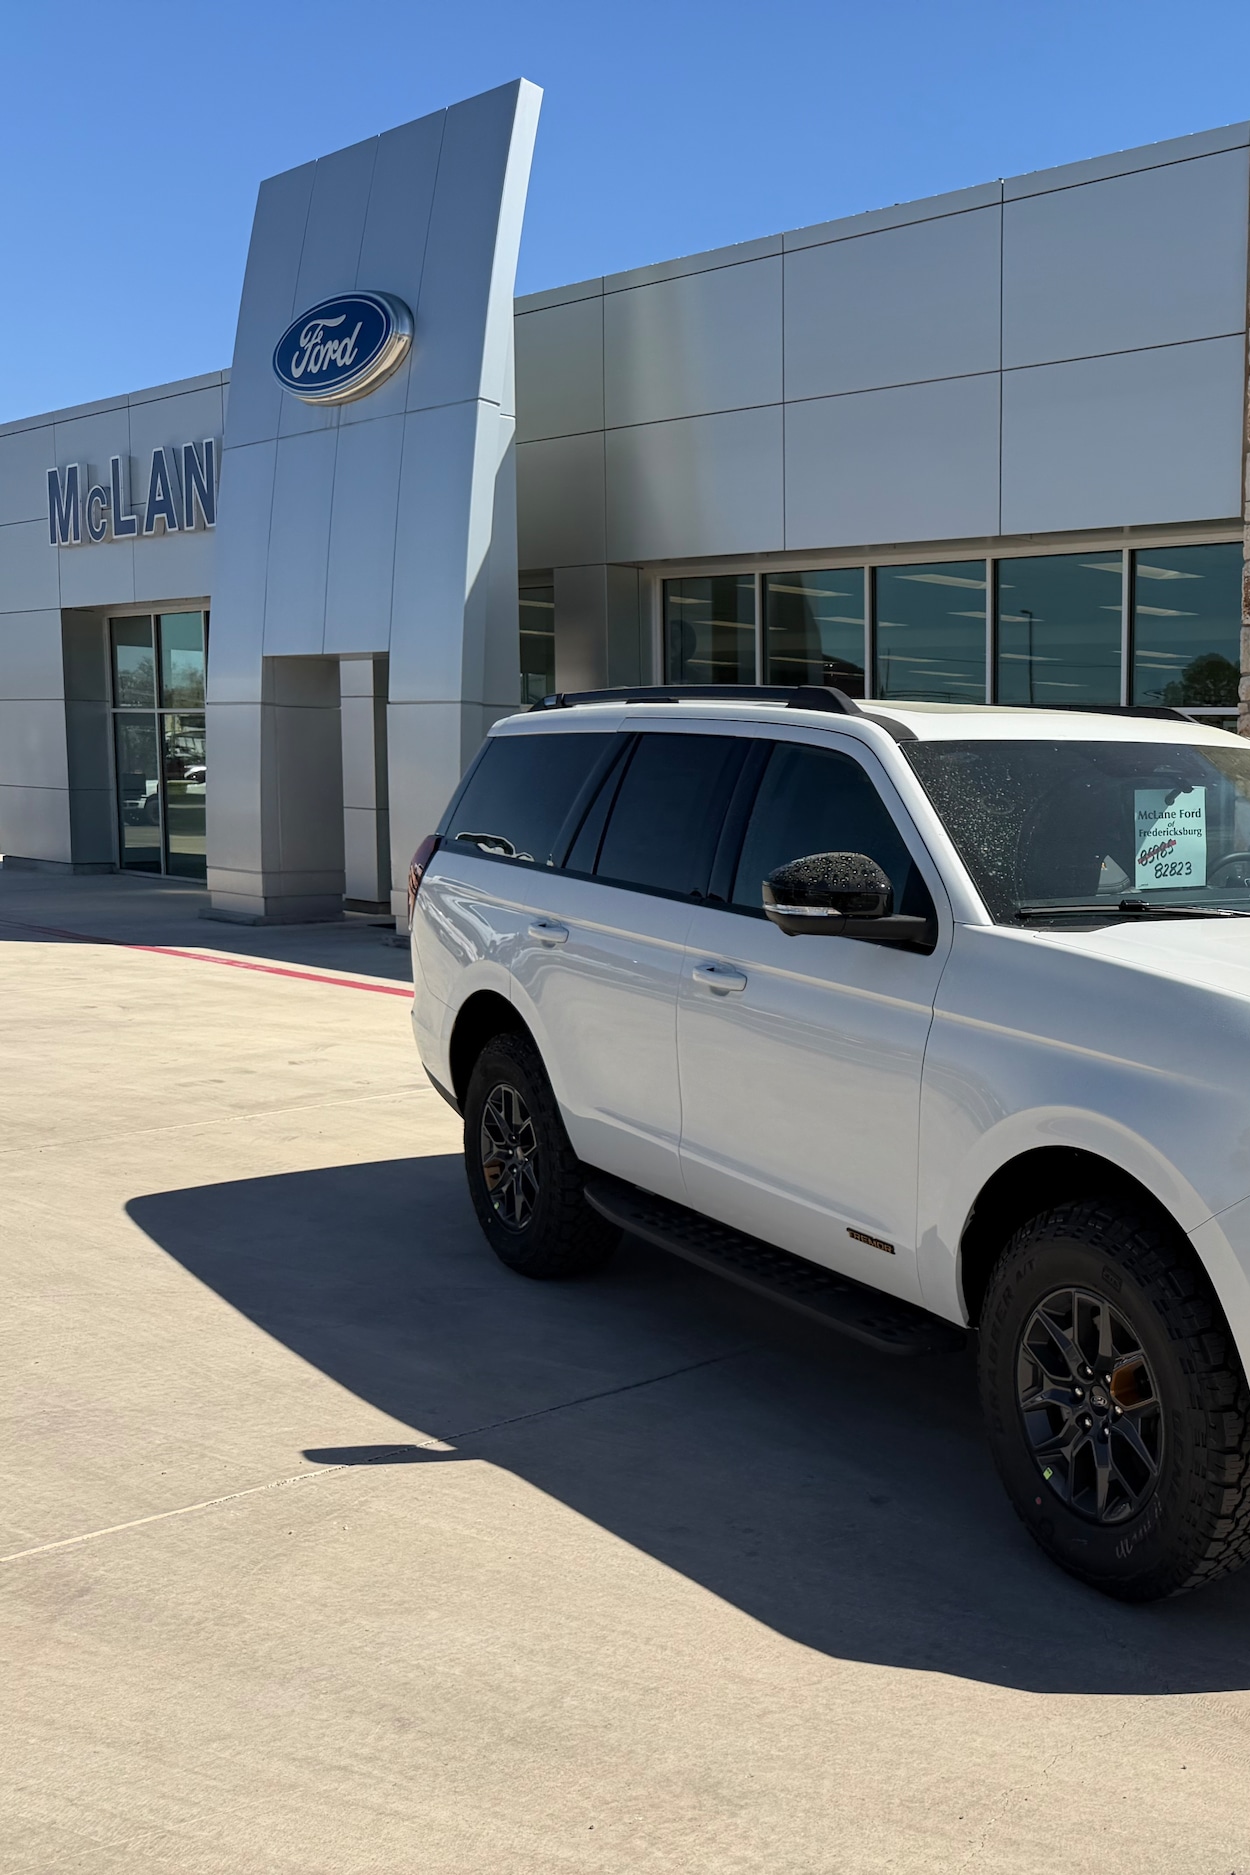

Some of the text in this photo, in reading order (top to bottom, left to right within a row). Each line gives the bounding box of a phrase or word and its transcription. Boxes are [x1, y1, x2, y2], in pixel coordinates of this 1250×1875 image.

[290, 313, 364, 379] Ford
[1138, 808, 1201, 820] McLane Ford
[1138, 827, 1202, 837] Fredericksburg
[1154, 861, 1193, 879] 82823
